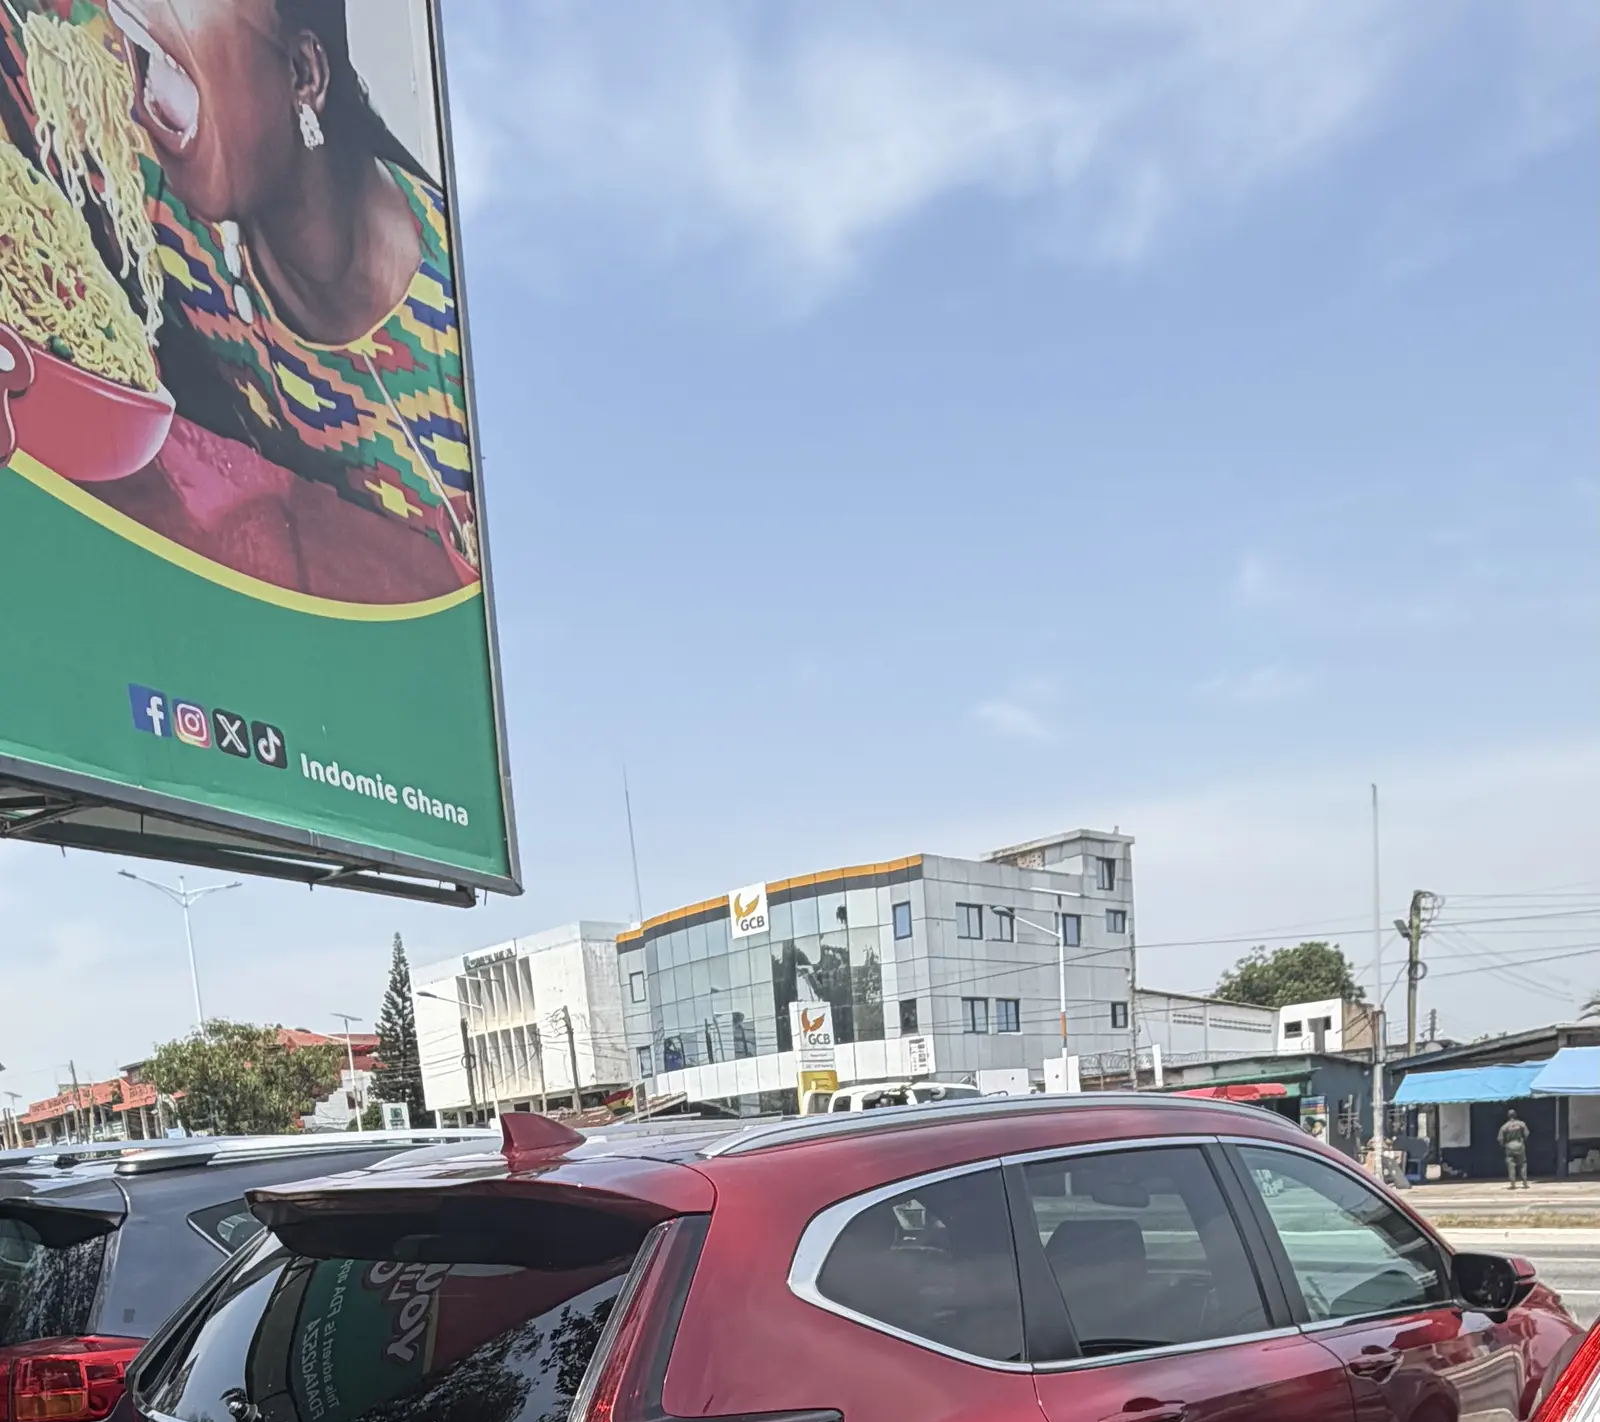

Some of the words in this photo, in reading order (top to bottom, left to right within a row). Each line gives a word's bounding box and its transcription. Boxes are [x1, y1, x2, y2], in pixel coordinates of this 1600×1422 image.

[300, 752, 398, 804] Indomie
[401, 786, 469, 827] Ghana
[740, 915, 765, 932] GCB
[808, 1033, 831, 1045] GCB
